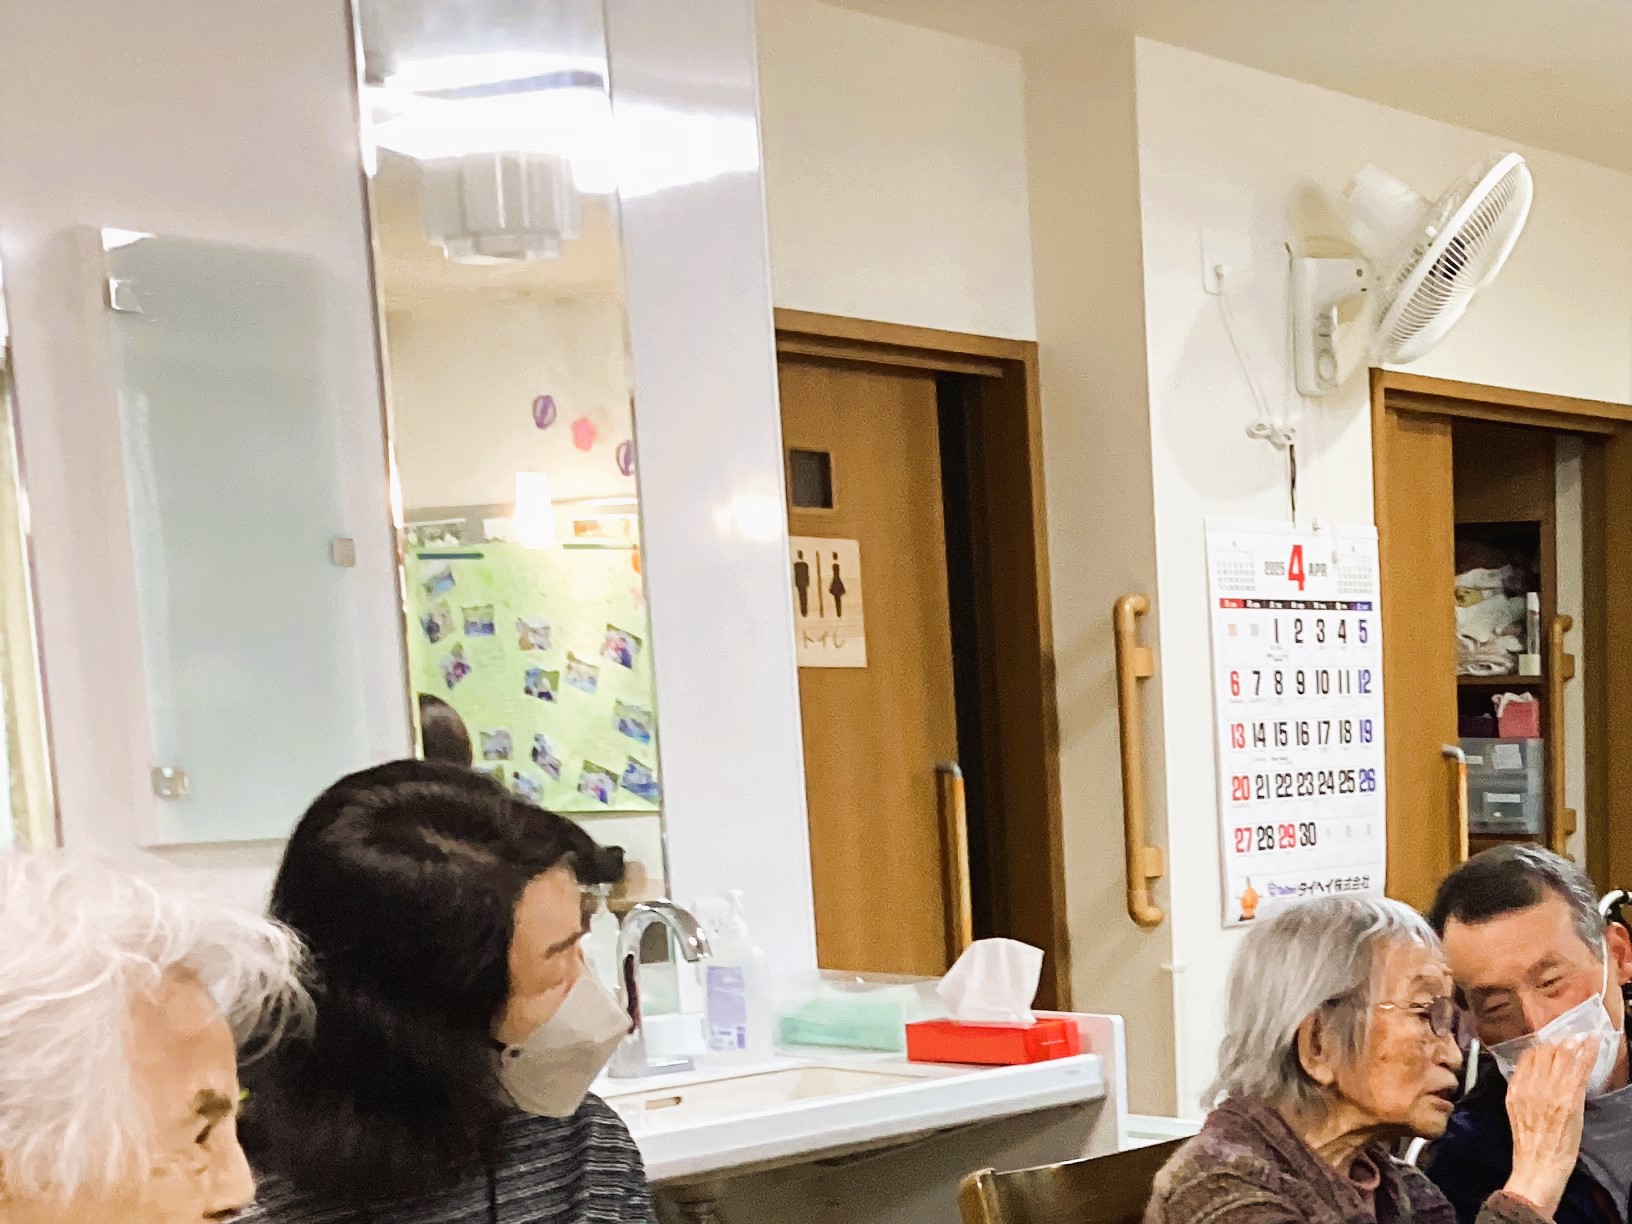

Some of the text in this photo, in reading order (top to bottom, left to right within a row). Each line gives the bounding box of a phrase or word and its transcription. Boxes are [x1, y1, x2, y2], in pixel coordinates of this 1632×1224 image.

[1288, 544, 1305, 591] 4
[801, 628, 846, 649] トイレ
[1274, 618, 1279, 644] 1
[1295, 618, 1303, 644] 2
[1317, 619, 1325, 643] 3
[1338, 619, 1347, 644] 4
[1359, 619, 1367, 644] 5
[1230, 669, 1372, 696] 6 7 8 9 10 11 12
[1231, 719, 1373, 749] 13 14 15 16 17 18 19
[1232, 768, 1376, 801] 20 21 22 23 24 25 26
[1235, 828, 1252, 853] 27
[1257, 826, 1274, 851] 28
[1278, 824, 1296, 849] 29
[1300, 822, 1317, 847] 30
[1298, 874, 1370, 896] タイヘイ株式会社
